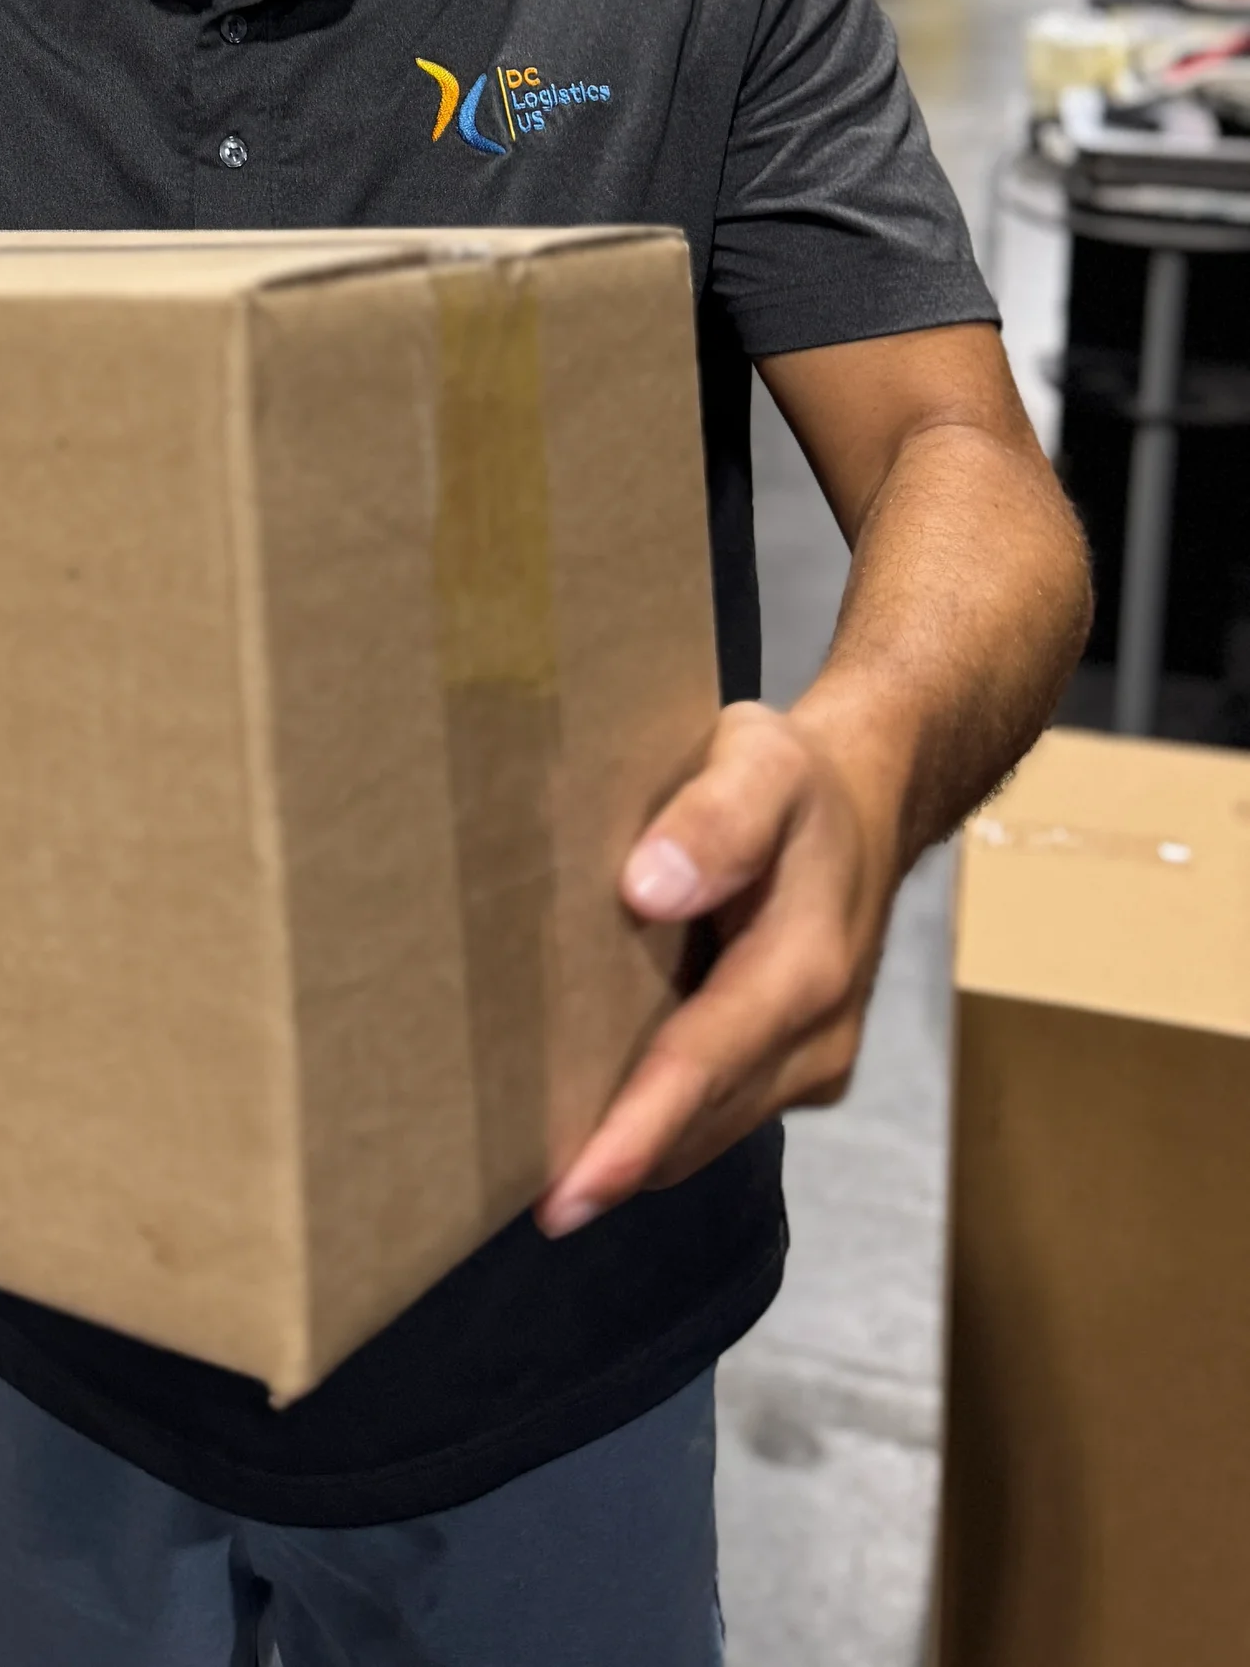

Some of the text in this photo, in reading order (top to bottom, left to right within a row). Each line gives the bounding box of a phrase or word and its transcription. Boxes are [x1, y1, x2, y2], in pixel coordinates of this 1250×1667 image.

[505, 67, 540, 88] DC
[511, 81, 611, 111] Logistics
[517, 111, 545, 133] US
